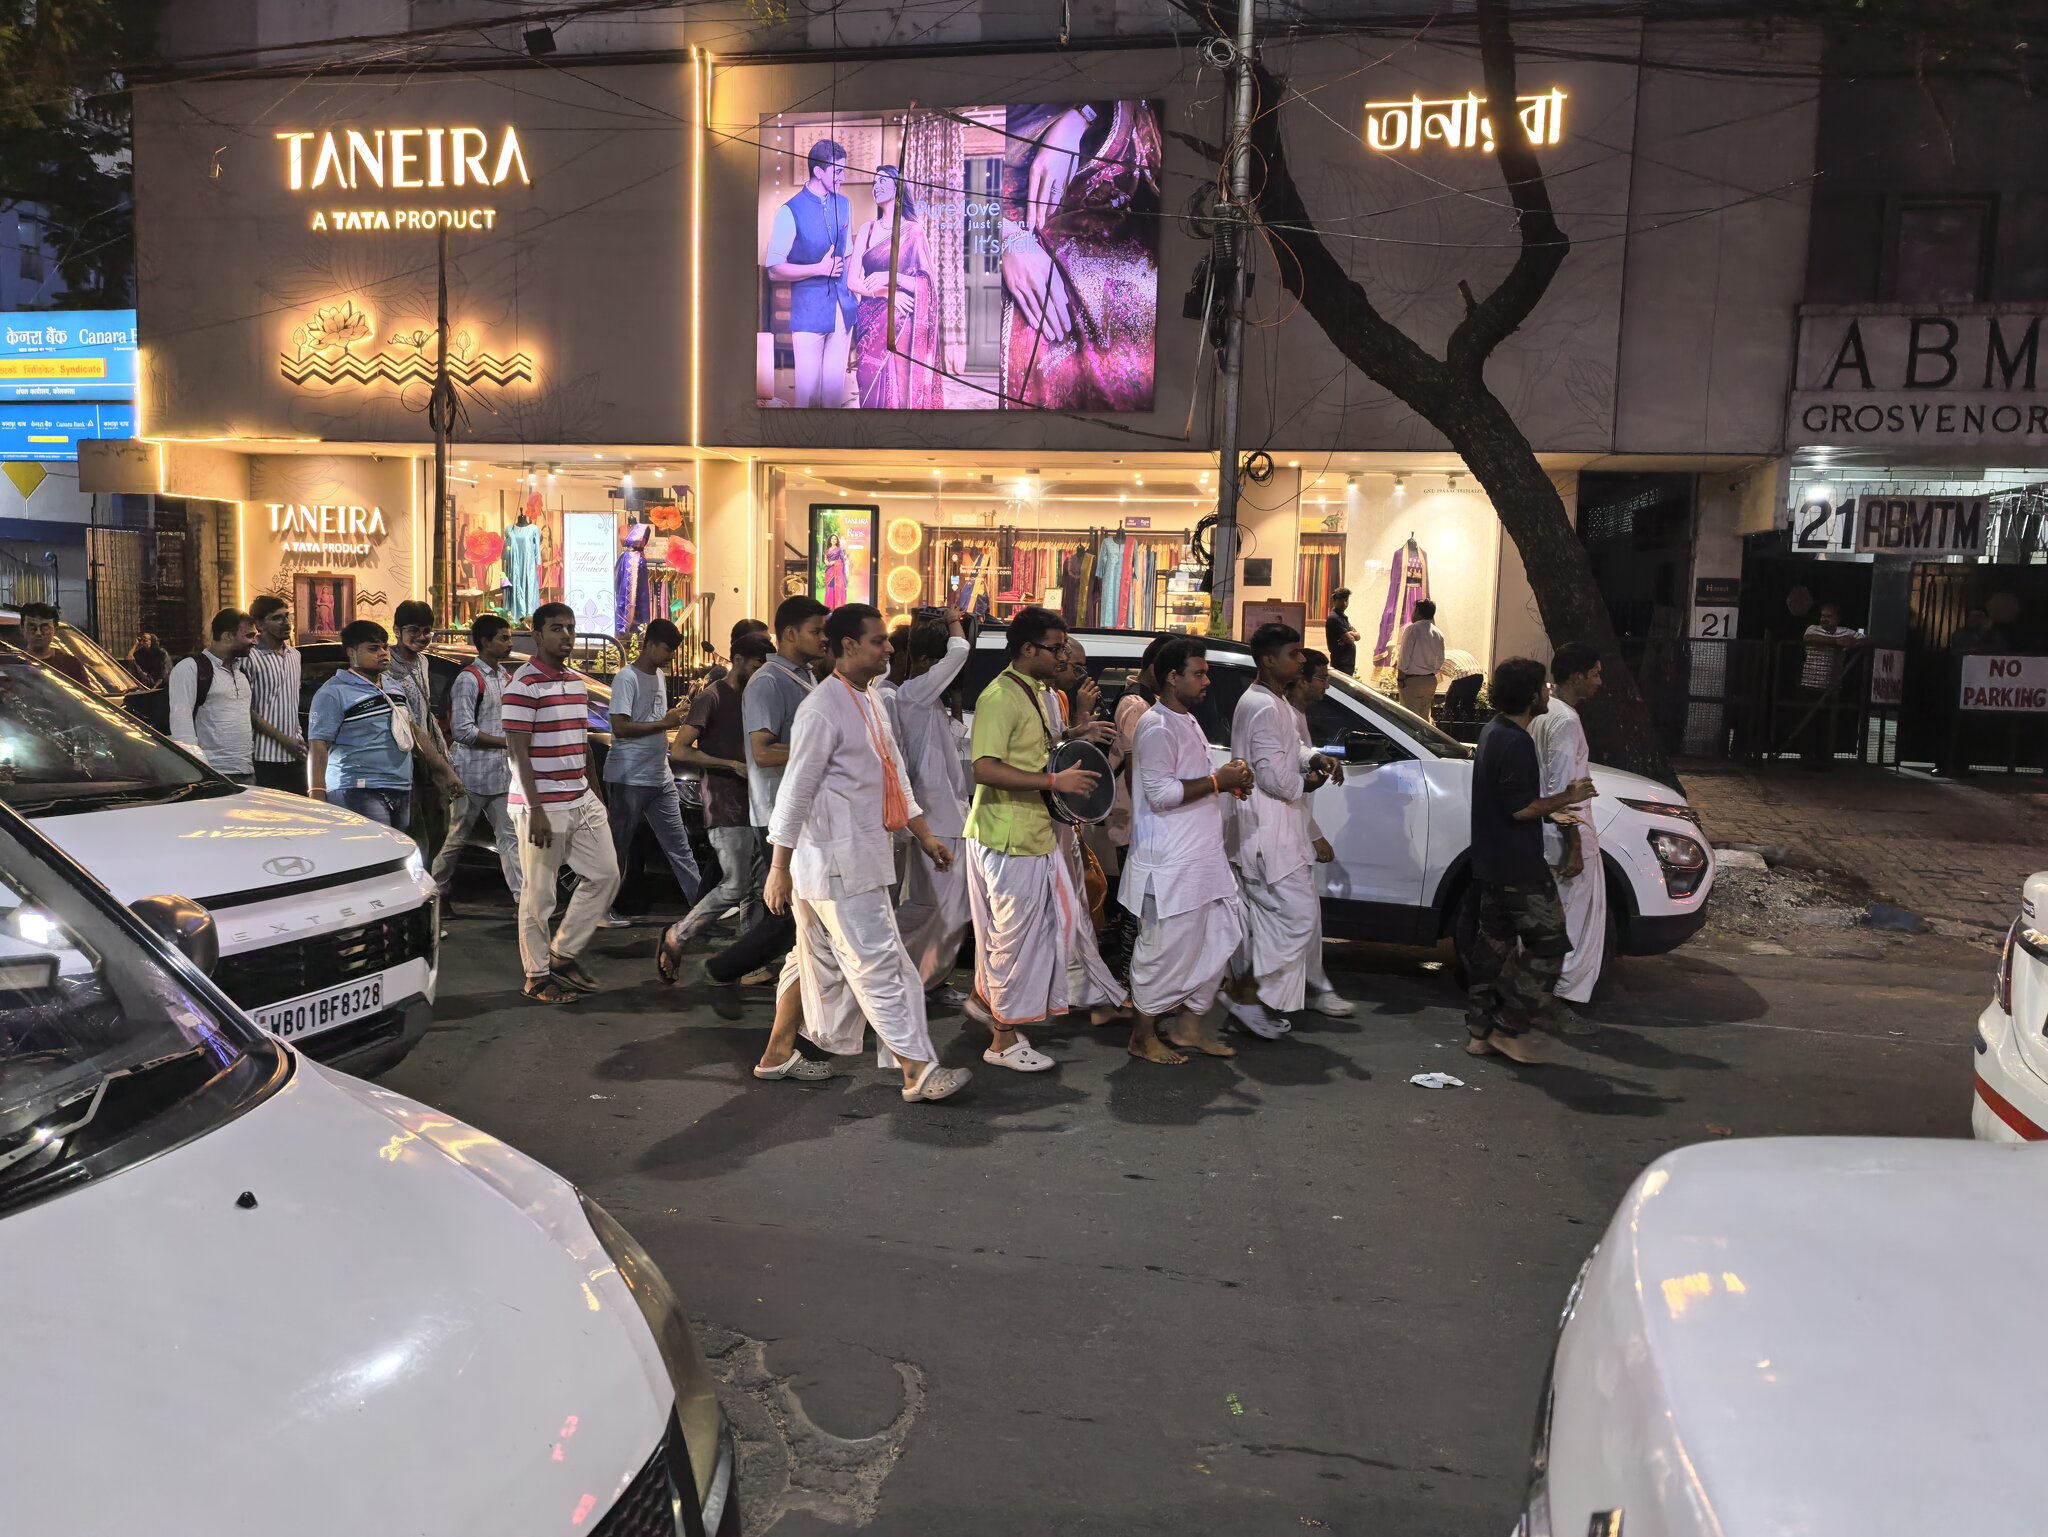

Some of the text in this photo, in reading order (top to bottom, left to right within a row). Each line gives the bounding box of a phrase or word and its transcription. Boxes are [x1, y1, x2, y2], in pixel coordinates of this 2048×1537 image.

[276, 126, 531, 190] TANEIRA
[916, 199, 1000, 218] Pure love
[312, 209, 496, 231] A TATA PRODUCT
[967, 219, 991, 232] just
[974, 235, 1000, 255] It's
[6, 326, 68, 345] केनरा बैंक
[79, 328, 127, 345] Canara
[1822, 316, 2042, 390] ABM
[60, 365, 101, 376] Syndicate
[1802, 404, 2048, 434] GROSVENOR
[264, 504, 387, 536] TANEIRA
[1798, 498, 1856, 549] 21
[1863, 500, 1982, 550] ABMTM
[283, 543, 371, 555] A TATA PRODUCT
[572, 551, 610, 566] Valley of
[572, 562, 609, 573] Flowers
[1701, 613, 1730, 638] 21
[1989, 658, 2023, 678] NO
[1963, 686, 2048, 709] PARKING
[231, 899, 386, 943] EXTER
[270, 982, 381, 1037] WB01BF8328
